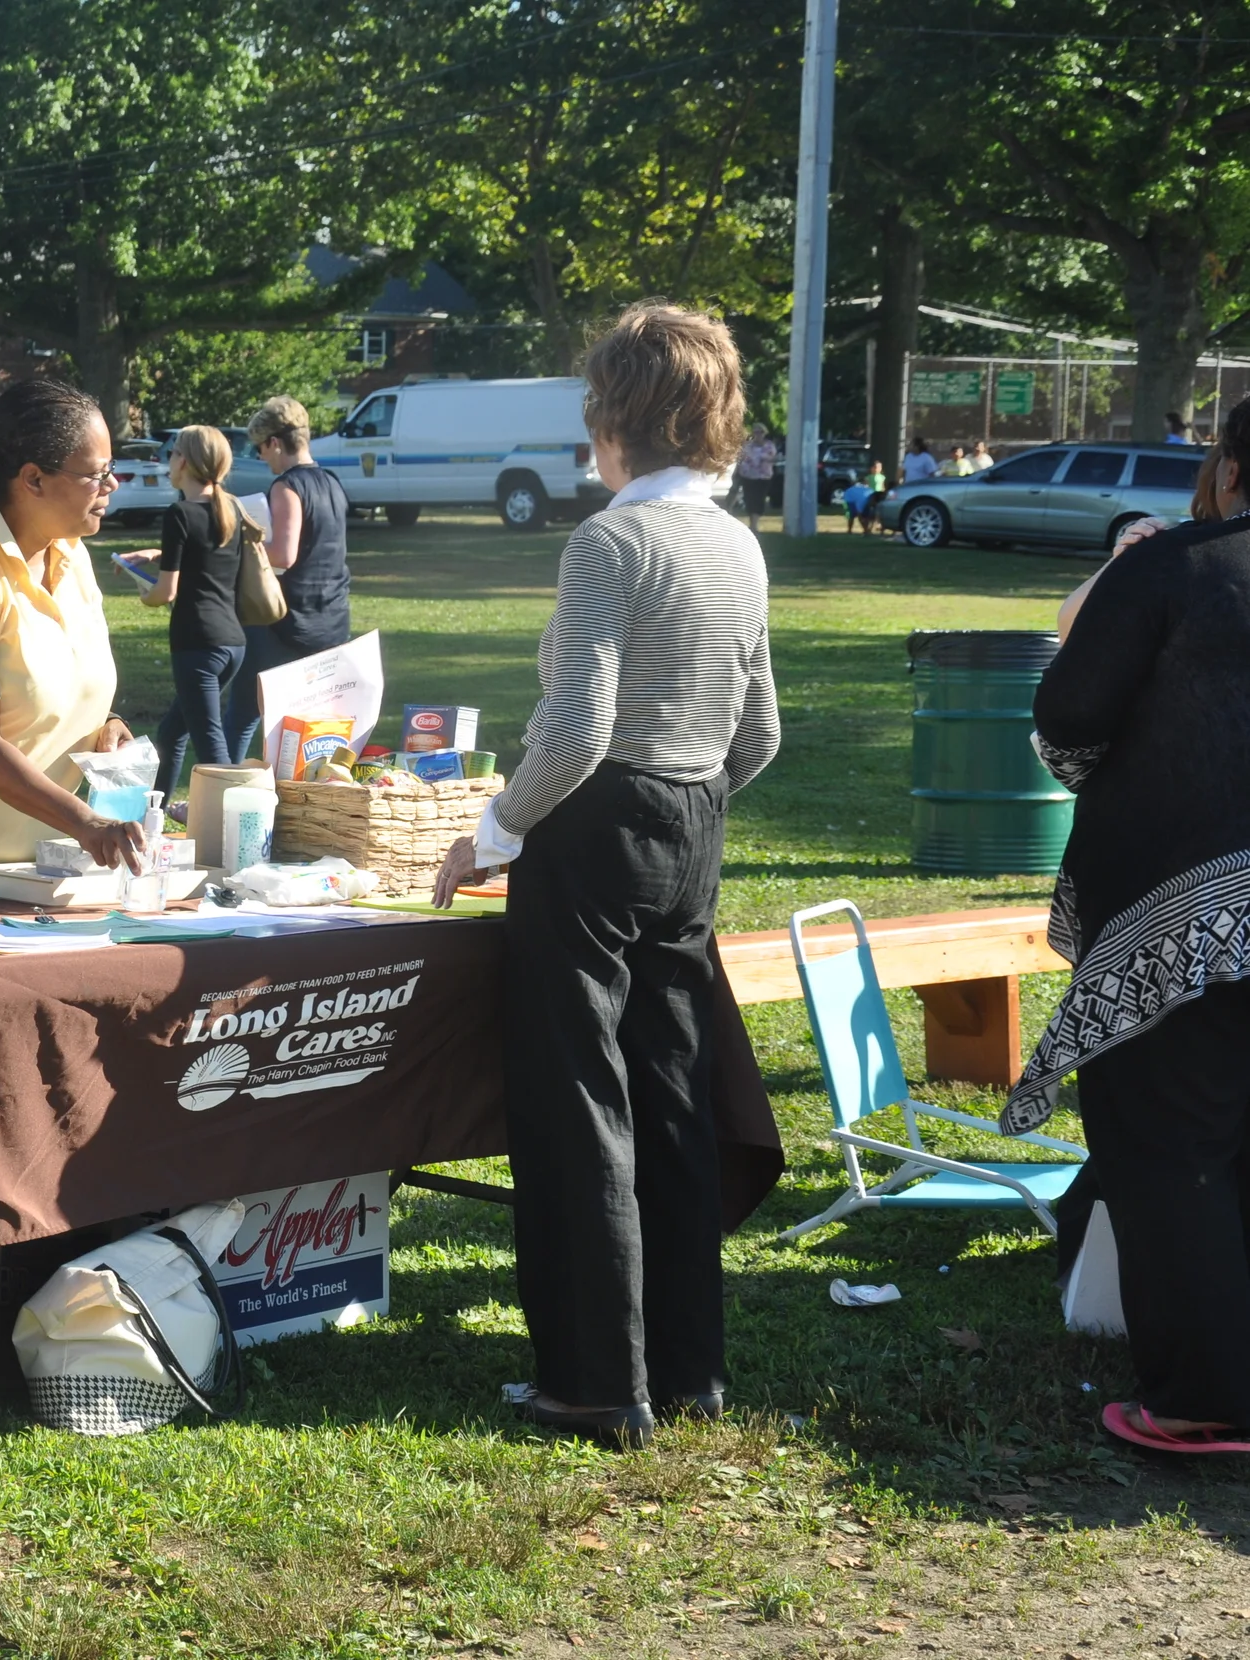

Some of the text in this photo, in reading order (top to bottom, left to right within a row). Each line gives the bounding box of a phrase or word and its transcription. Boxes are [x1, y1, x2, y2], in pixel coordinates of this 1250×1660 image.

[334, 680, 358, 691] Pantry
[418, 716, 441, 726] Barilla
[420, 765, 455, 778] Companion
[200, 989, 239, 1003] BECAUSE
[247, 984, 274, 997] TAKES
[273, 981, 298, 993] MORE
[299, 979, 322, 990] THAN
[322, 975, 344, 986] FOOD
[345, 973, 356, 982] TO
[356, 969, 376, 980] FEED
[377, 966, 392, 977] THE
[393, 959, 424, 973] HUNGRY
[182, 974, 421, 1044] Long Island
[275, 1022, 398, 1062] Cares INC
[247, 1052, 389, 1085] The Harry Chapin Food Bank
[238, 1279, 348, 1314] The World's Finest
